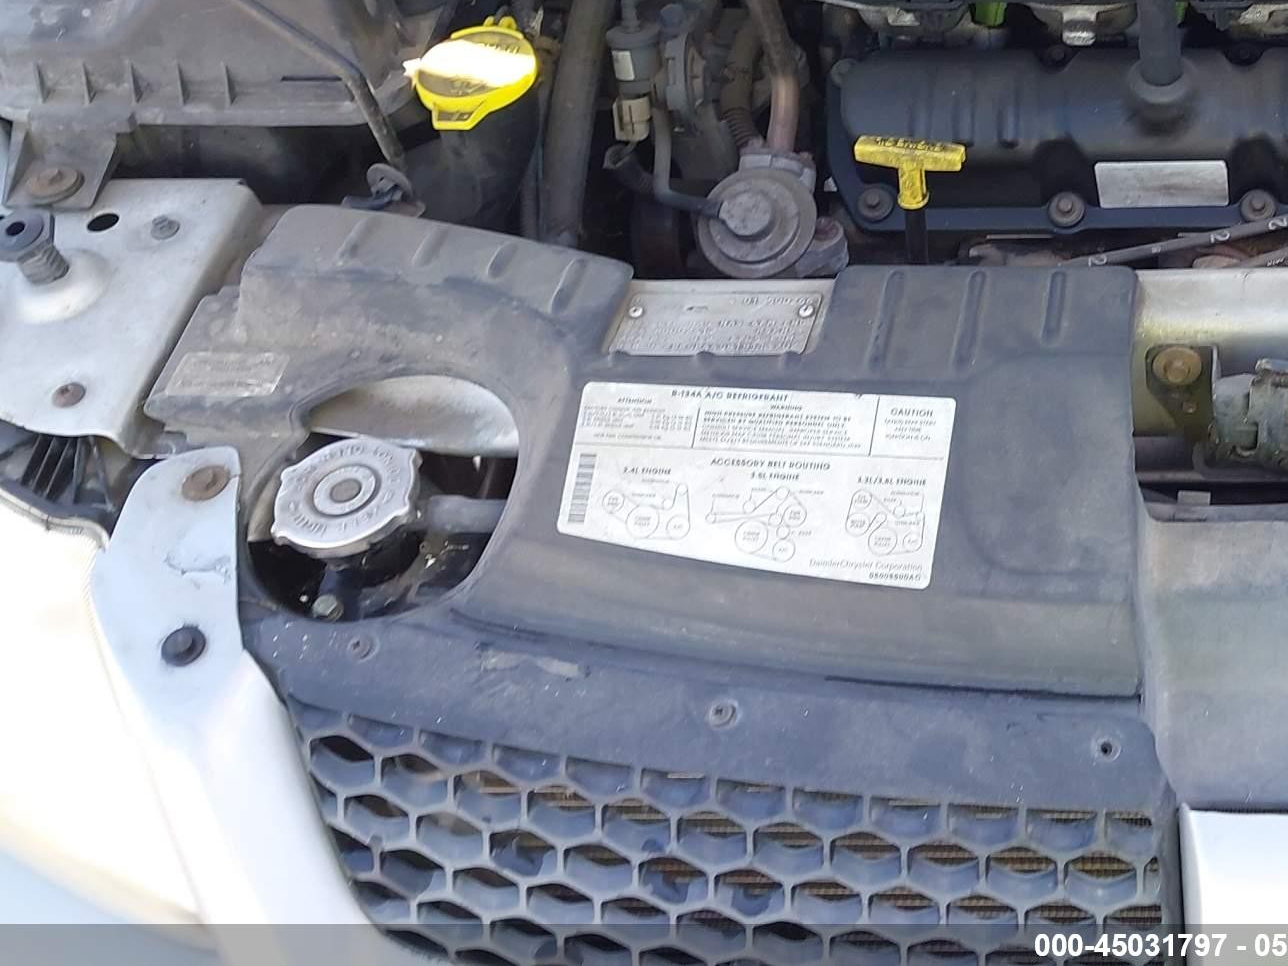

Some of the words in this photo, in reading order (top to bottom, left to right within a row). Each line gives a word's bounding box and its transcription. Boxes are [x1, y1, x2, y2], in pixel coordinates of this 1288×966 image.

[705, 391, 723, 399] A/C
[726, 393, 788, 402] REFRIGERANT
[891, 408, 934, 417] CAUTION
[711, 458, 764, 467] ACCESSORY
[768, 459, 786, 468] BELT
[789, 460, 831, 470] ROUTING
[641, 467, 671, 475] ENGINE
[769, 472, 800, 480] ENGINE
[896, 477, 926, 486] ENGINE
[876, 561, 923, 572] Corporation
